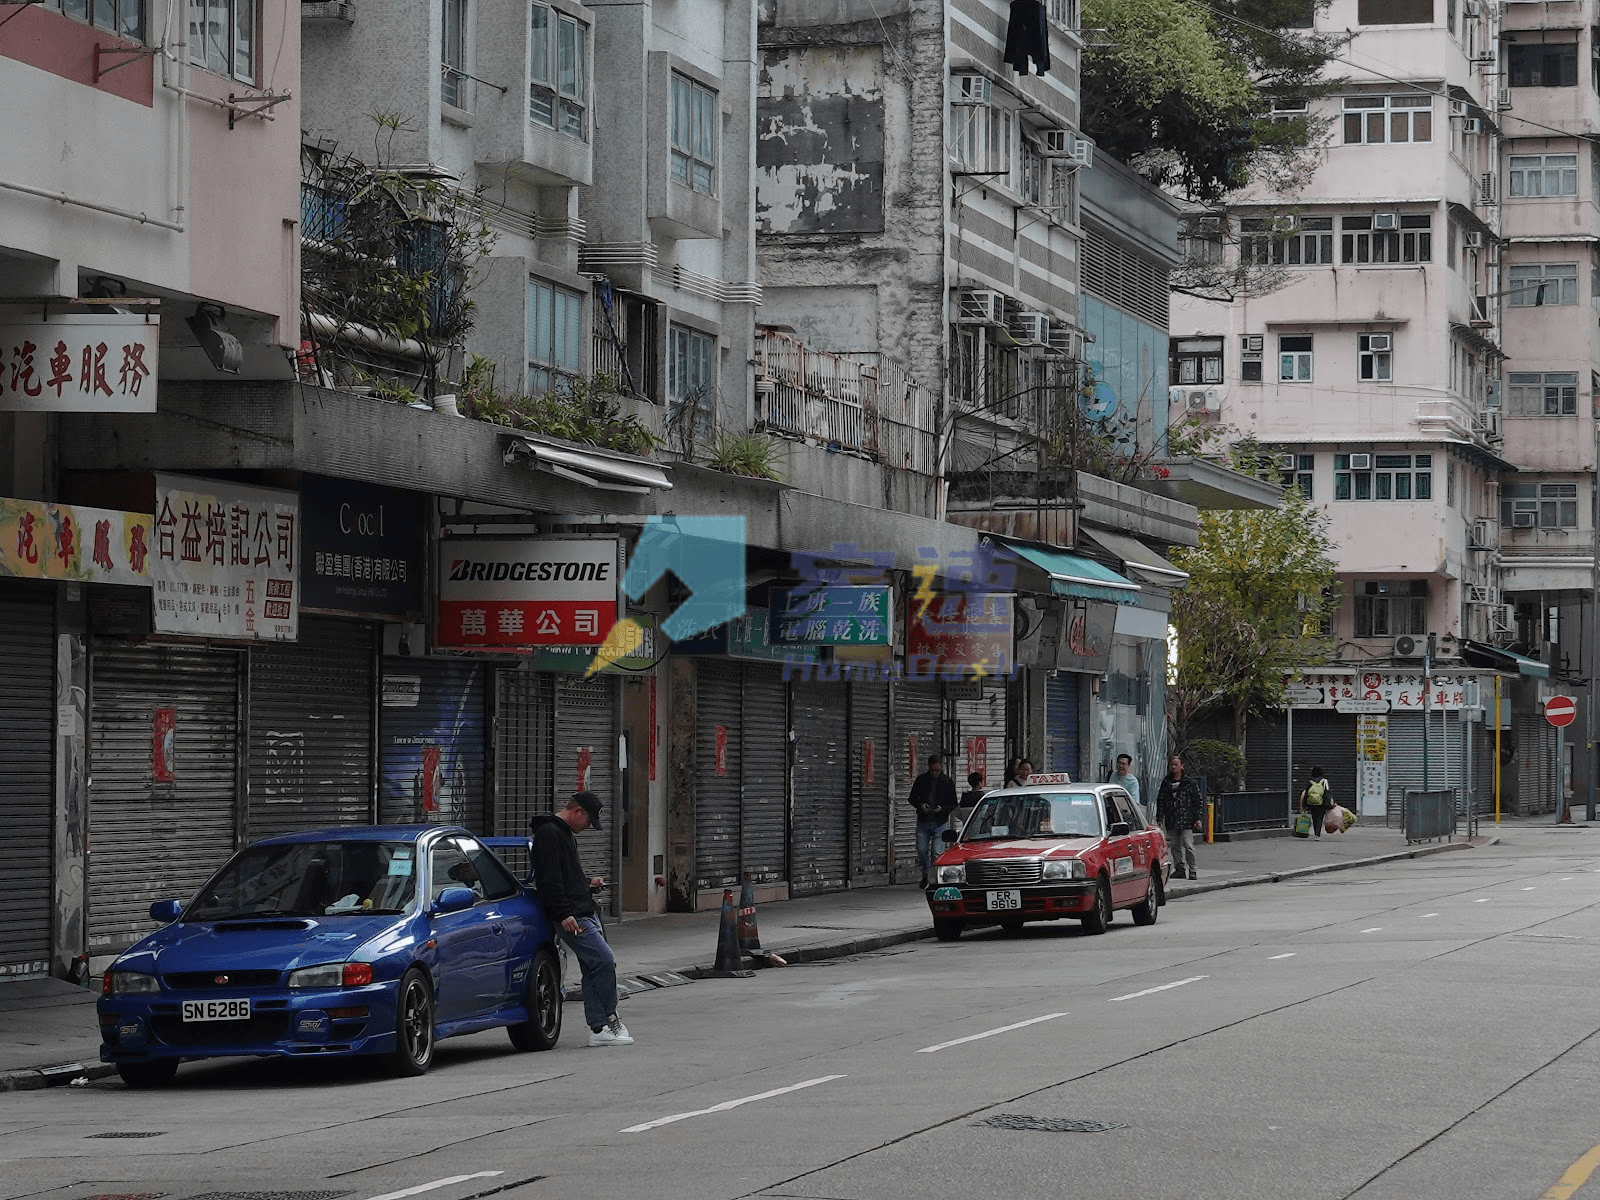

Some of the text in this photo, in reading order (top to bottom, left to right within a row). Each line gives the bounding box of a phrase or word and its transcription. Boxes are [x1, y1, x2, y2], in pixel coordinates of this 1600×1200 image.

[18, 511, 148, 574] 汽車服務
[448, 559, 610, 582] BRIDGESTONE
[782, 591, 881, 613] 上班一族
[460, 608, 599, 637] 萬華公司
[778, 618, 881, 642] 電腦乾洗
[915, 642, 1002, 658] 批發及零售
[1030, 774, 1065, 783] TAXI
[991, 899, 1018, 909] 9619
[996, 891, 1011, 900] ER
[183, 1001, 249, 1019] SN 6286
